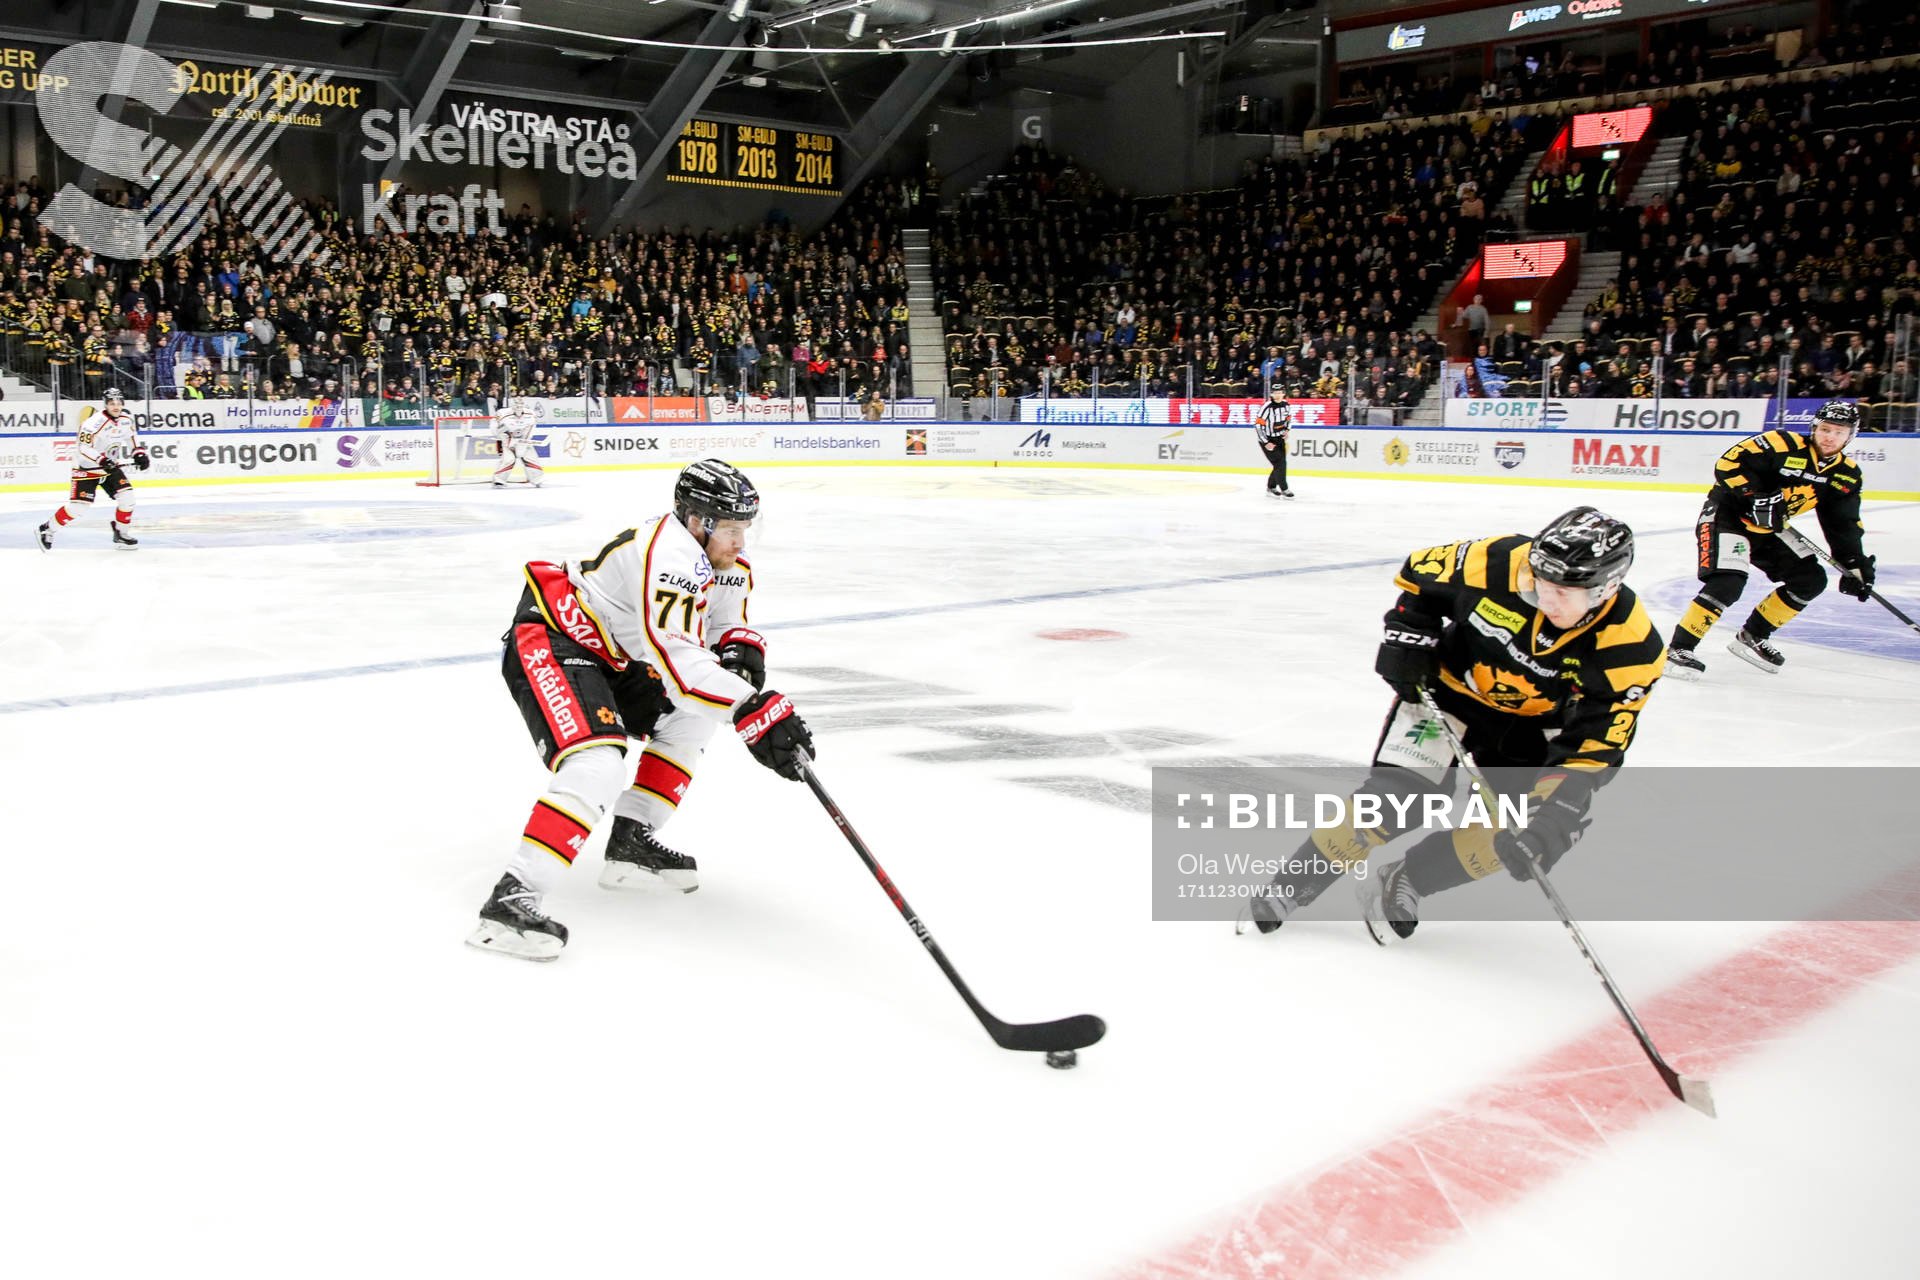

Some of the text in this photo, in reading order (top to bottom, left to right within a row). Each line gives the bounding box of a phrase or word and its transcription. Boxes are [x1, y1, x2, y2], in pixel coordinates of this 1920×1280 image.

[0, 48, 37, 69] ER
[22, 72, 69, 93] UPP
[167, 60, 361, 109] North Power
[451, 102, 615, 143] VÄSTRA STÅ
[1021, 115, 1042, 139] G
[737, 125, 777, 146] SM-GULD
[795, 132, 833, 151] SM-GULD
[678, 140, 718, 174] 1978
[737, 145, 778, 179] 2013
[795, 152, 833, 185] 2014
[362, 179, 507, 236] Kraft
[227, 405, 308, 418] Holmlunds
[1467, 402, 1538, 416] SPORT
[1614, 404, 1741, 429] Henson
[80, 432, 92, 444] 89
[774, 436, 880, 449] Handelsbanken
[1062, 440, 1107, 450] Miljöteknik
[197, 442, 317, 471] engcon
[385, 451, 410, 462] Kraft
[1158, 444, 1180, 459] EY
[1291, 440, 1358, 458] JELOIN
[1572, 438, 1661, 468] MAXI
[1437, 455, 1478, 466] HOCKEY
[1587, 467, 1660, 477] STORMARKNAD
[669, 575, 699, 594] LKAB
[655, 589, 696, 634] 71
[1385, 629, 1440, 648] CCM
